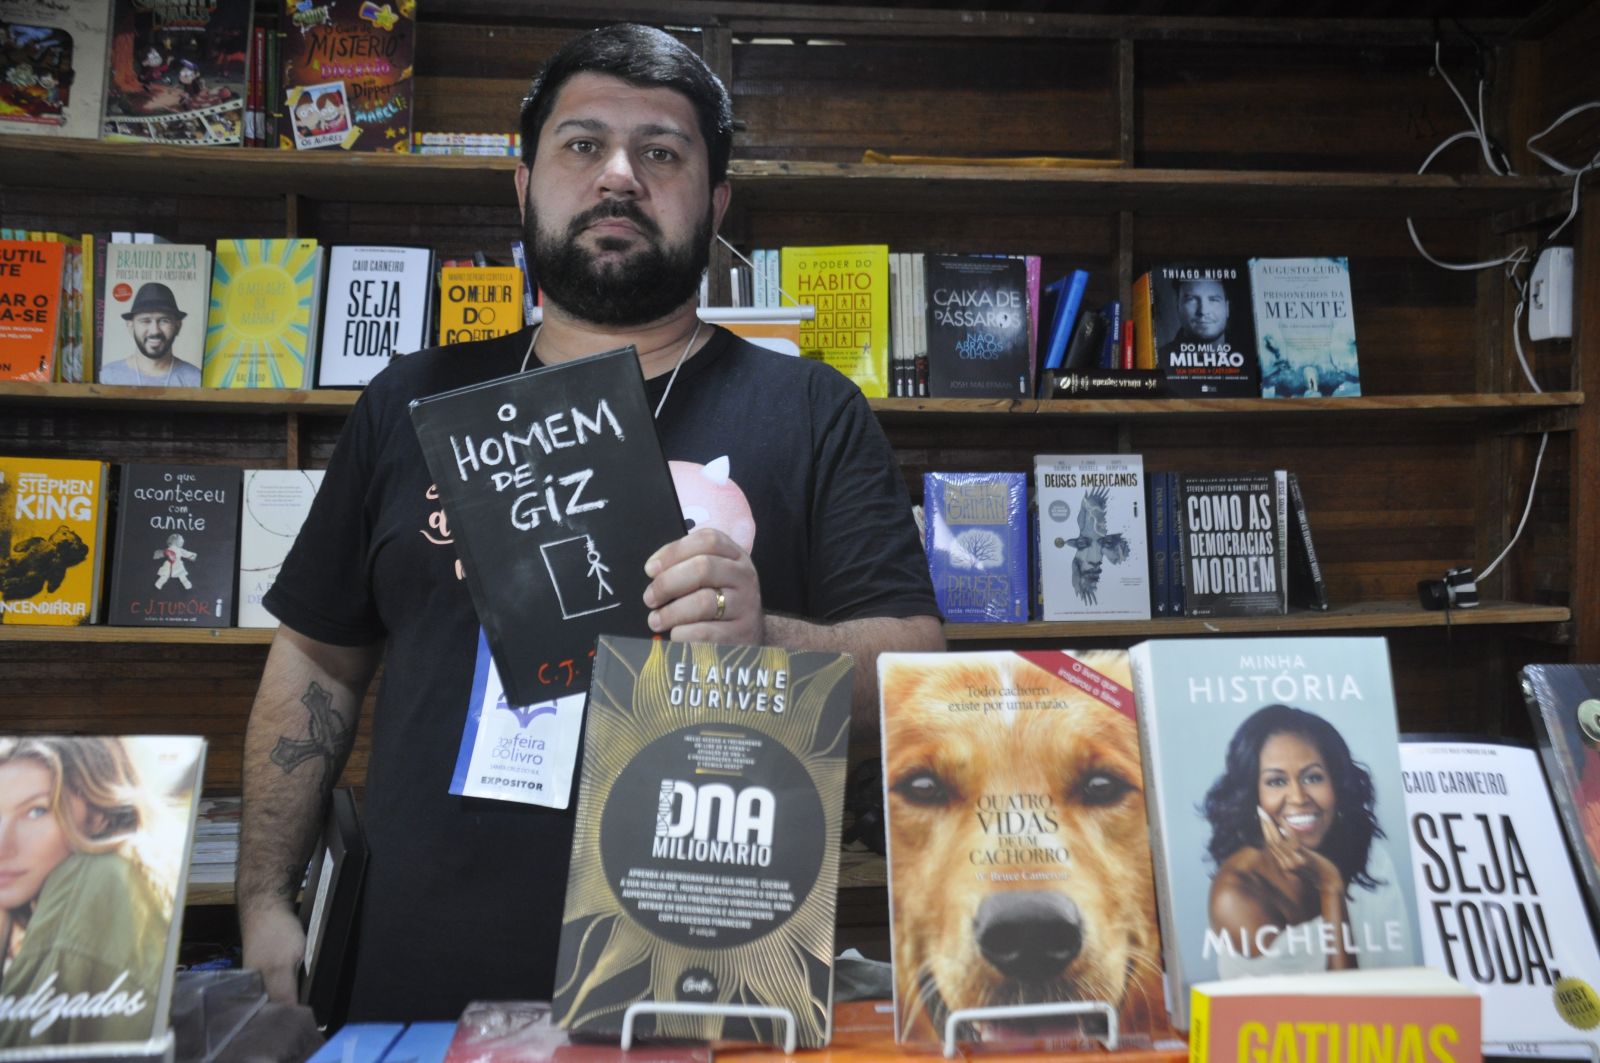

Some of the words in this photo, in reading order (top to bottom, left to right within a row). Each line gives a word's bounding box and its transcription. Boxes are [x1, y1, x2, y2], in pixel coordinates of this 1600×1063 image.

[166, 250, 197, 270] BESSA
[352, 260, 368, 272] CAIO
[370, 260, 405, 273] CARNEIRO
[798, 261, 807, 270] O
[813, 260, 849, 270] PODER
[856, 259, 872, 268] DO
[1262, 265, 1310, 274] AUGUSTO
[1313, 264, 1341, 274] CURY
[798, 270, 872, 292] HÁBITO
[1162, 268, 1199, 279] THIAGO
[1205, 269, 1237, 279] NIGRO
[33, 294, 49, 308] O
[347, 280, 401, 318] SEJA
[448, 285, 466, 303] O
[468, 285, 512, 303] MELHOR
[933, 289, 993, 307] CAIXA
[996, 290, 1021, 308] DE
[1263, 291, 1329, 300] PRISIONEIROS
[1331, 290, 1345, 298] DA
[463, 307, 495, 325] DO
[934, 306, 1021, 328] PÁSSAROS
[1265, 301, 1347, 319] MENTE
[343, 320, 400, 357] FODA!
[1180, 344, 1196, 352] DO
[1198, 344, 1215, 353] MIL
[1216, 344, 1232, 353] AO
[959, 350, 999, 360] OLHOS
[1169, 352, 1244, 367] MILHÃO
[450, 399, 625, 481] HOMEM
[17, 478, 94, 495] STEPHEN
[177, 473, 197, 483] que
[491, 463, 535, 493] DE
[1044, 473, 1077, 488] DEUSES
[1081, 473, 1138, 488] AMERICANOS
[134, 484, 225, 504] aconteceu
[1186, 485, 1204, 493] STEVEN
[15, 494, 92, 521] KING
[168, 505, 188, 513] com
[1187, 494, 1243, 532] COMO
[1249, 493, 1272, 530] AS
[150, 513, 205, 531] annie
[1190, 531, 1274, 557] DEMOCRACIAS
[1302, 530, 1316, 562] DEMOCRACIAS
[1310, 562, 1321, 582] MORREM
[1192, 556, 1277, 594] MORREM
[1238, 654, 1306, 670] MINHA
[673, 663, 787, 690] ELAINNE
[1058, 667, 1092, 692] inspirou
[1072, 662, 1081, 672] O
[1081, 667, 1101, 684] livro
[1101, 680, 1118, 694] que
[1187, 668, 1364, 704] HISTÓRIA
[670, 686, 786, 714] OURIVES
[966, 684, 997, 698] Todo
[998, 683, 1050, 697] cachorro
[948, 699, 981, 713] existe
[983, 699, 1004, 714] por
[1005, 699, 1034, 711] uma
[480, 776, 544, 792] EXPOSITOR
[1401, 771, 1437, 794] CAIO
[1438, 771, 1508, 796] CARNEIRO
[976, 793, 1054, 813] QUATRO
[976, 810, 1060, 835] VIDAS
[997, 836, 1014, 848] DE
[1015, 835, 1038, 848] UM
[969, 847, 1070, 867] CACHORRO
[1411, 811, 1539, 896] SEJA
[628, 868, 659, 879] APRENDA
[660, 870, 665, 880] A
[665, 871, 714, 883] REPROGRAMAR
[721, 876, 735, 886] SUA
[760, 879, 790, 890] COCRIAR
[990, 869, 1019, 882] Bruce
[1021, 868, 1070, 882] Cameron
[620, 878, 625, 887] A
[626, 879, 640, 888] SUA
[679, 883, 704, 893] MUDAR
[765, 891, 778, 900] SEU
[622, 889, 667, 900] AUMENTANDO
[673, 893, 687, 902] SUA
[729, 898, 772, 910] VIBRACIONAL
[773, 901, 791, 912] PARA
[638, 901, 664, 911] ENTRAR
[664, 903, 674, 912] EM
[728, 908, 775, 920] ALINHAMENTO
[658, 912, 673, 922] COM
[680, 914, 711, 926] SUCESSO
[711, 917, 752, 929] FINANCEIRO
[1201, 920, 1405, 961] MICHELLE
[1430, 899, 1561, 986] FODA!
[1558, 985, 1588, 1005] BEST
[1236, 1020, 1462, 1063] GATUNAS
